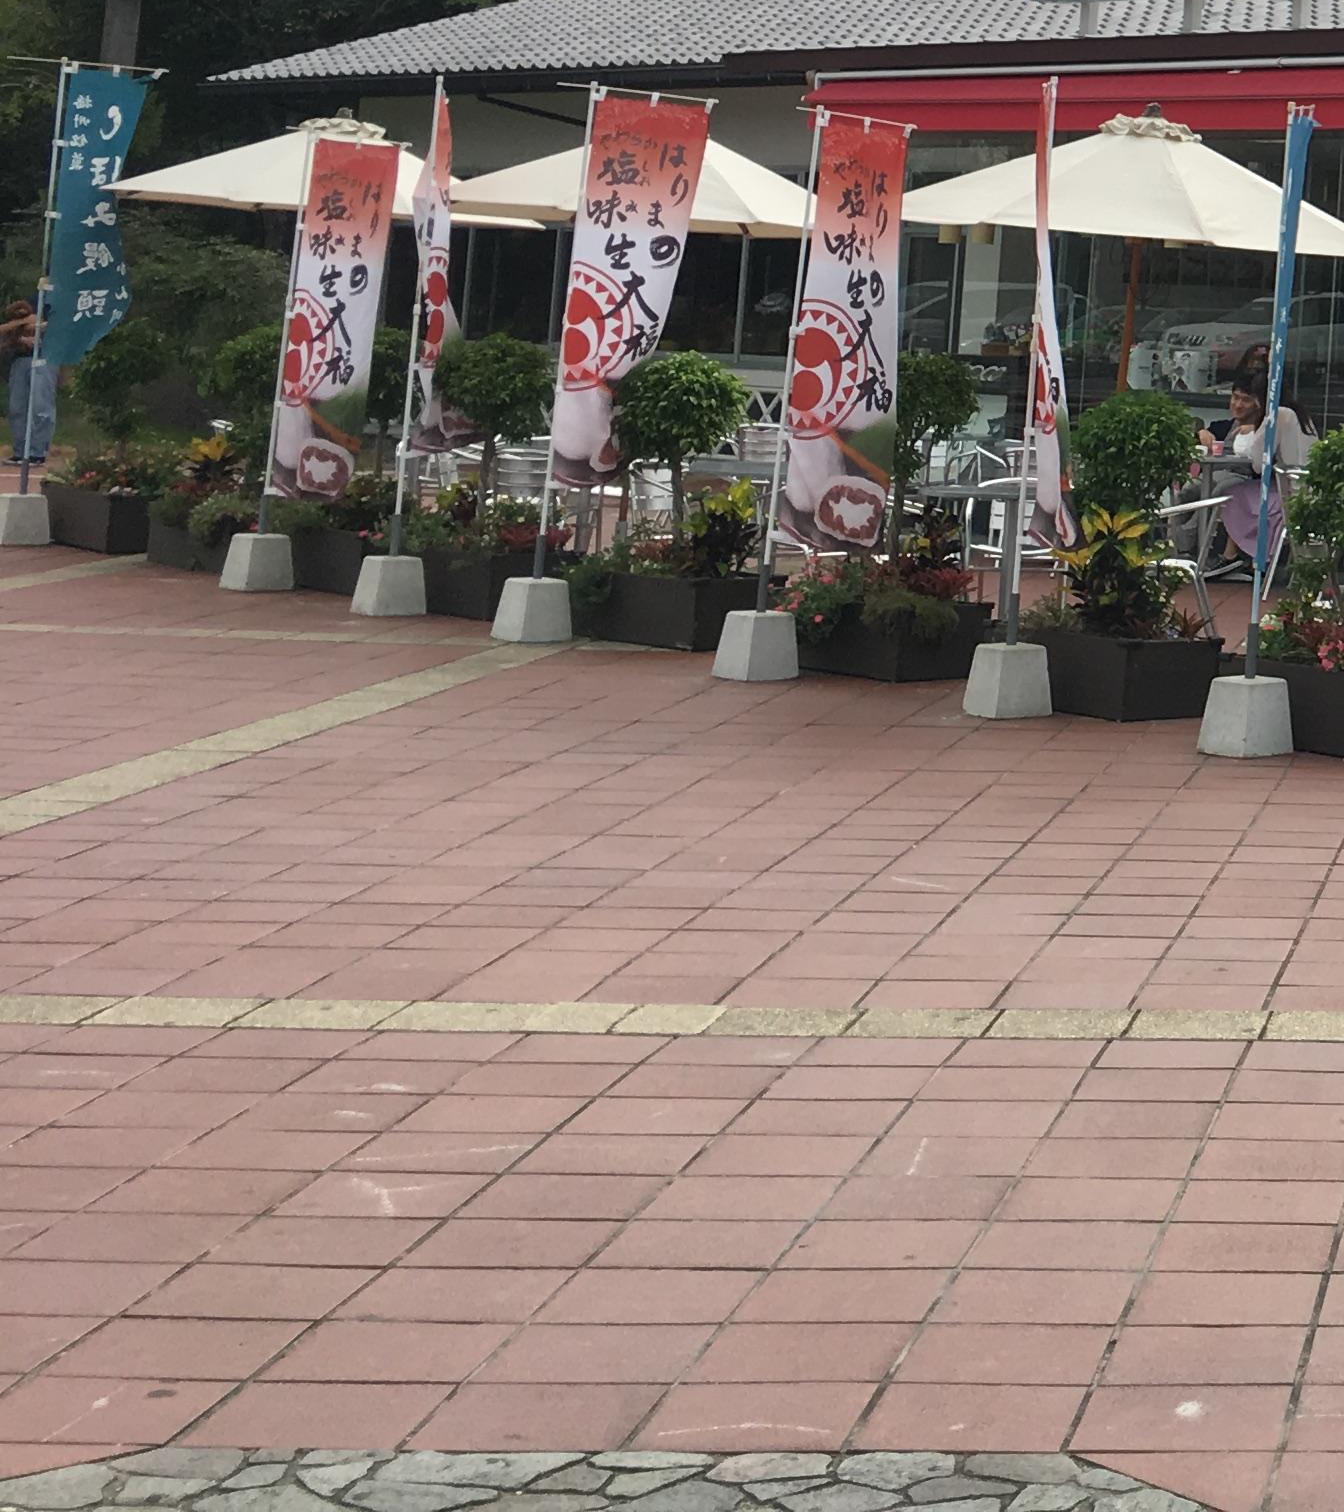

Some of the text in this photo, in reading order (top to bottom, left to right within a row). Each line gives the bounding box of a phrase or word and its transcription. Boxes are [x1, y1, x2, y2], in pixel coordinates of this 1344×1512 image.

[309, 189, 355, 386] 塩味生大福
[350, 181, 382, 296] はりまの
[587, 150, 660, 362] 塩味生大福
[647, 143, 689, 269] はりまの
[866, 169, 888, 307] はりまの
[823, 179, 894, 414] 塩味生大福
